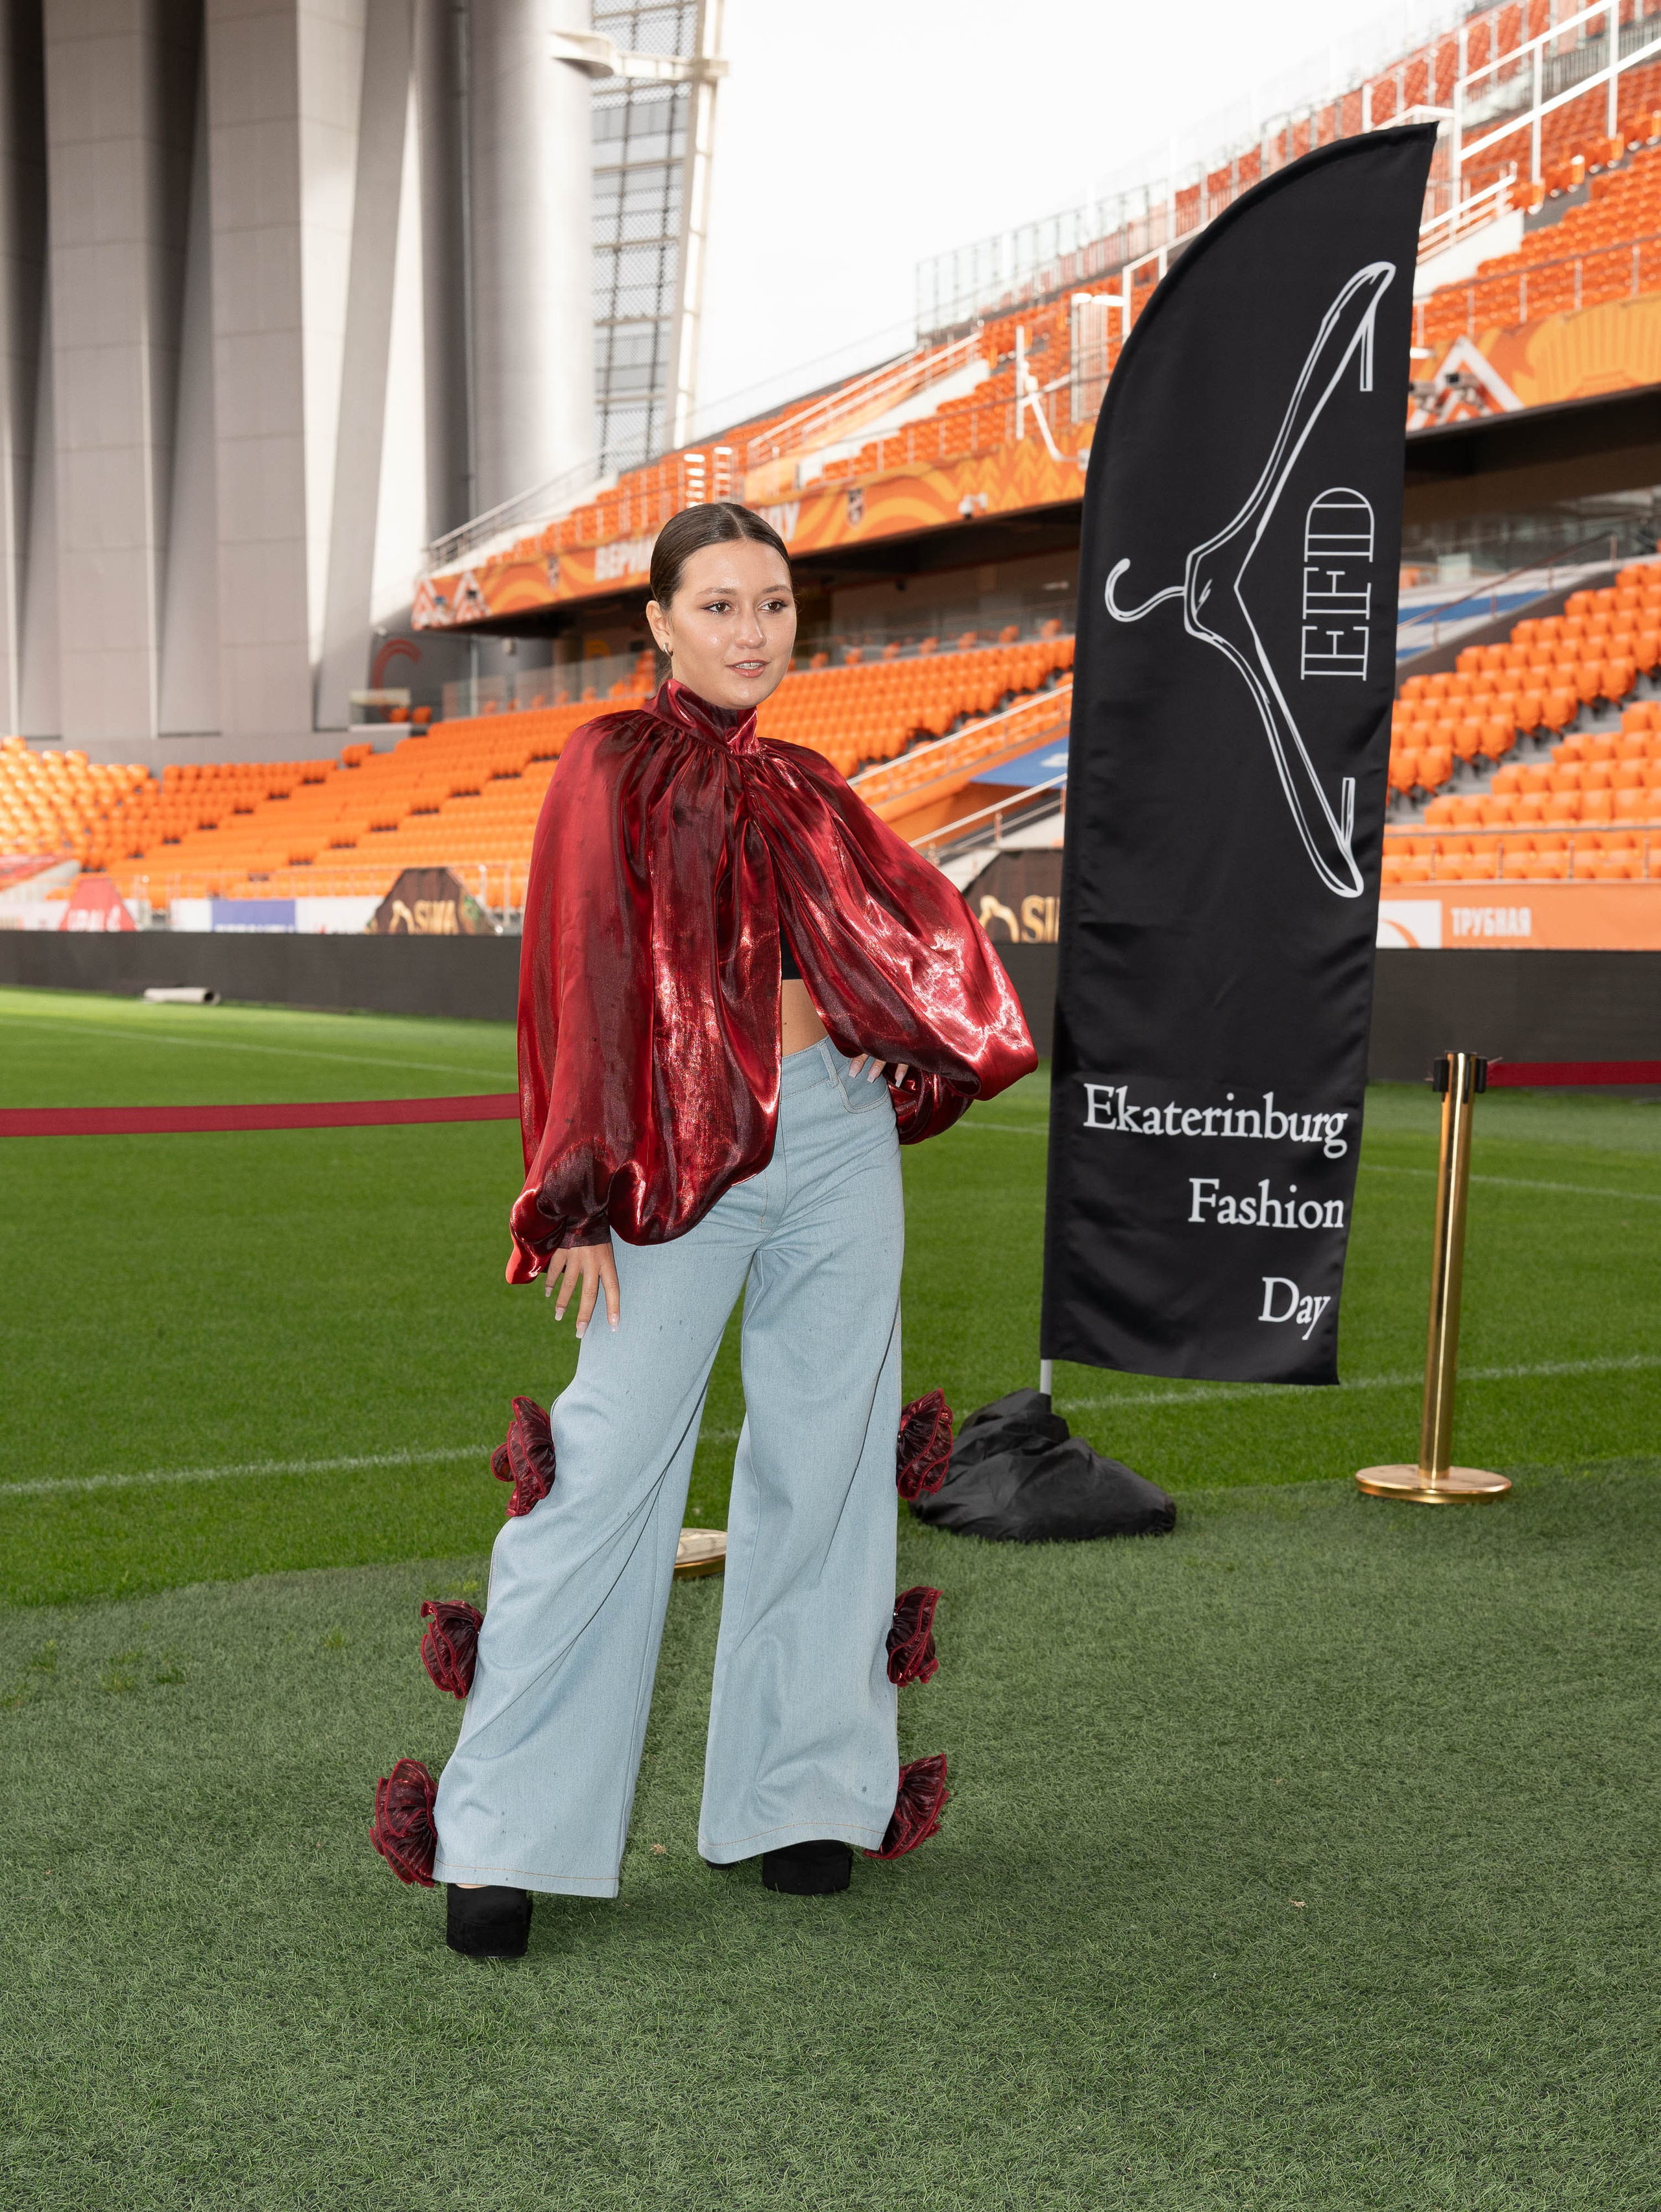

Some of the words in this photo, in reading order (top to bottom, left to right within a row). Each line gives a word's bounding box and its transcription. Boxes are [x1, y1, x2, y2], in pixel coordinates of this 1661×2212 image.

[1301, 488, 1374, 680] EFD
[1451, 907, 1532, 937] ТРУБНАЯ
[1084, 1083, 1348, 1158] Ekaterinburg
[1189, 1178, 1344, 1229] Fashion
[1259, 1277, 1331, 1340] Day
